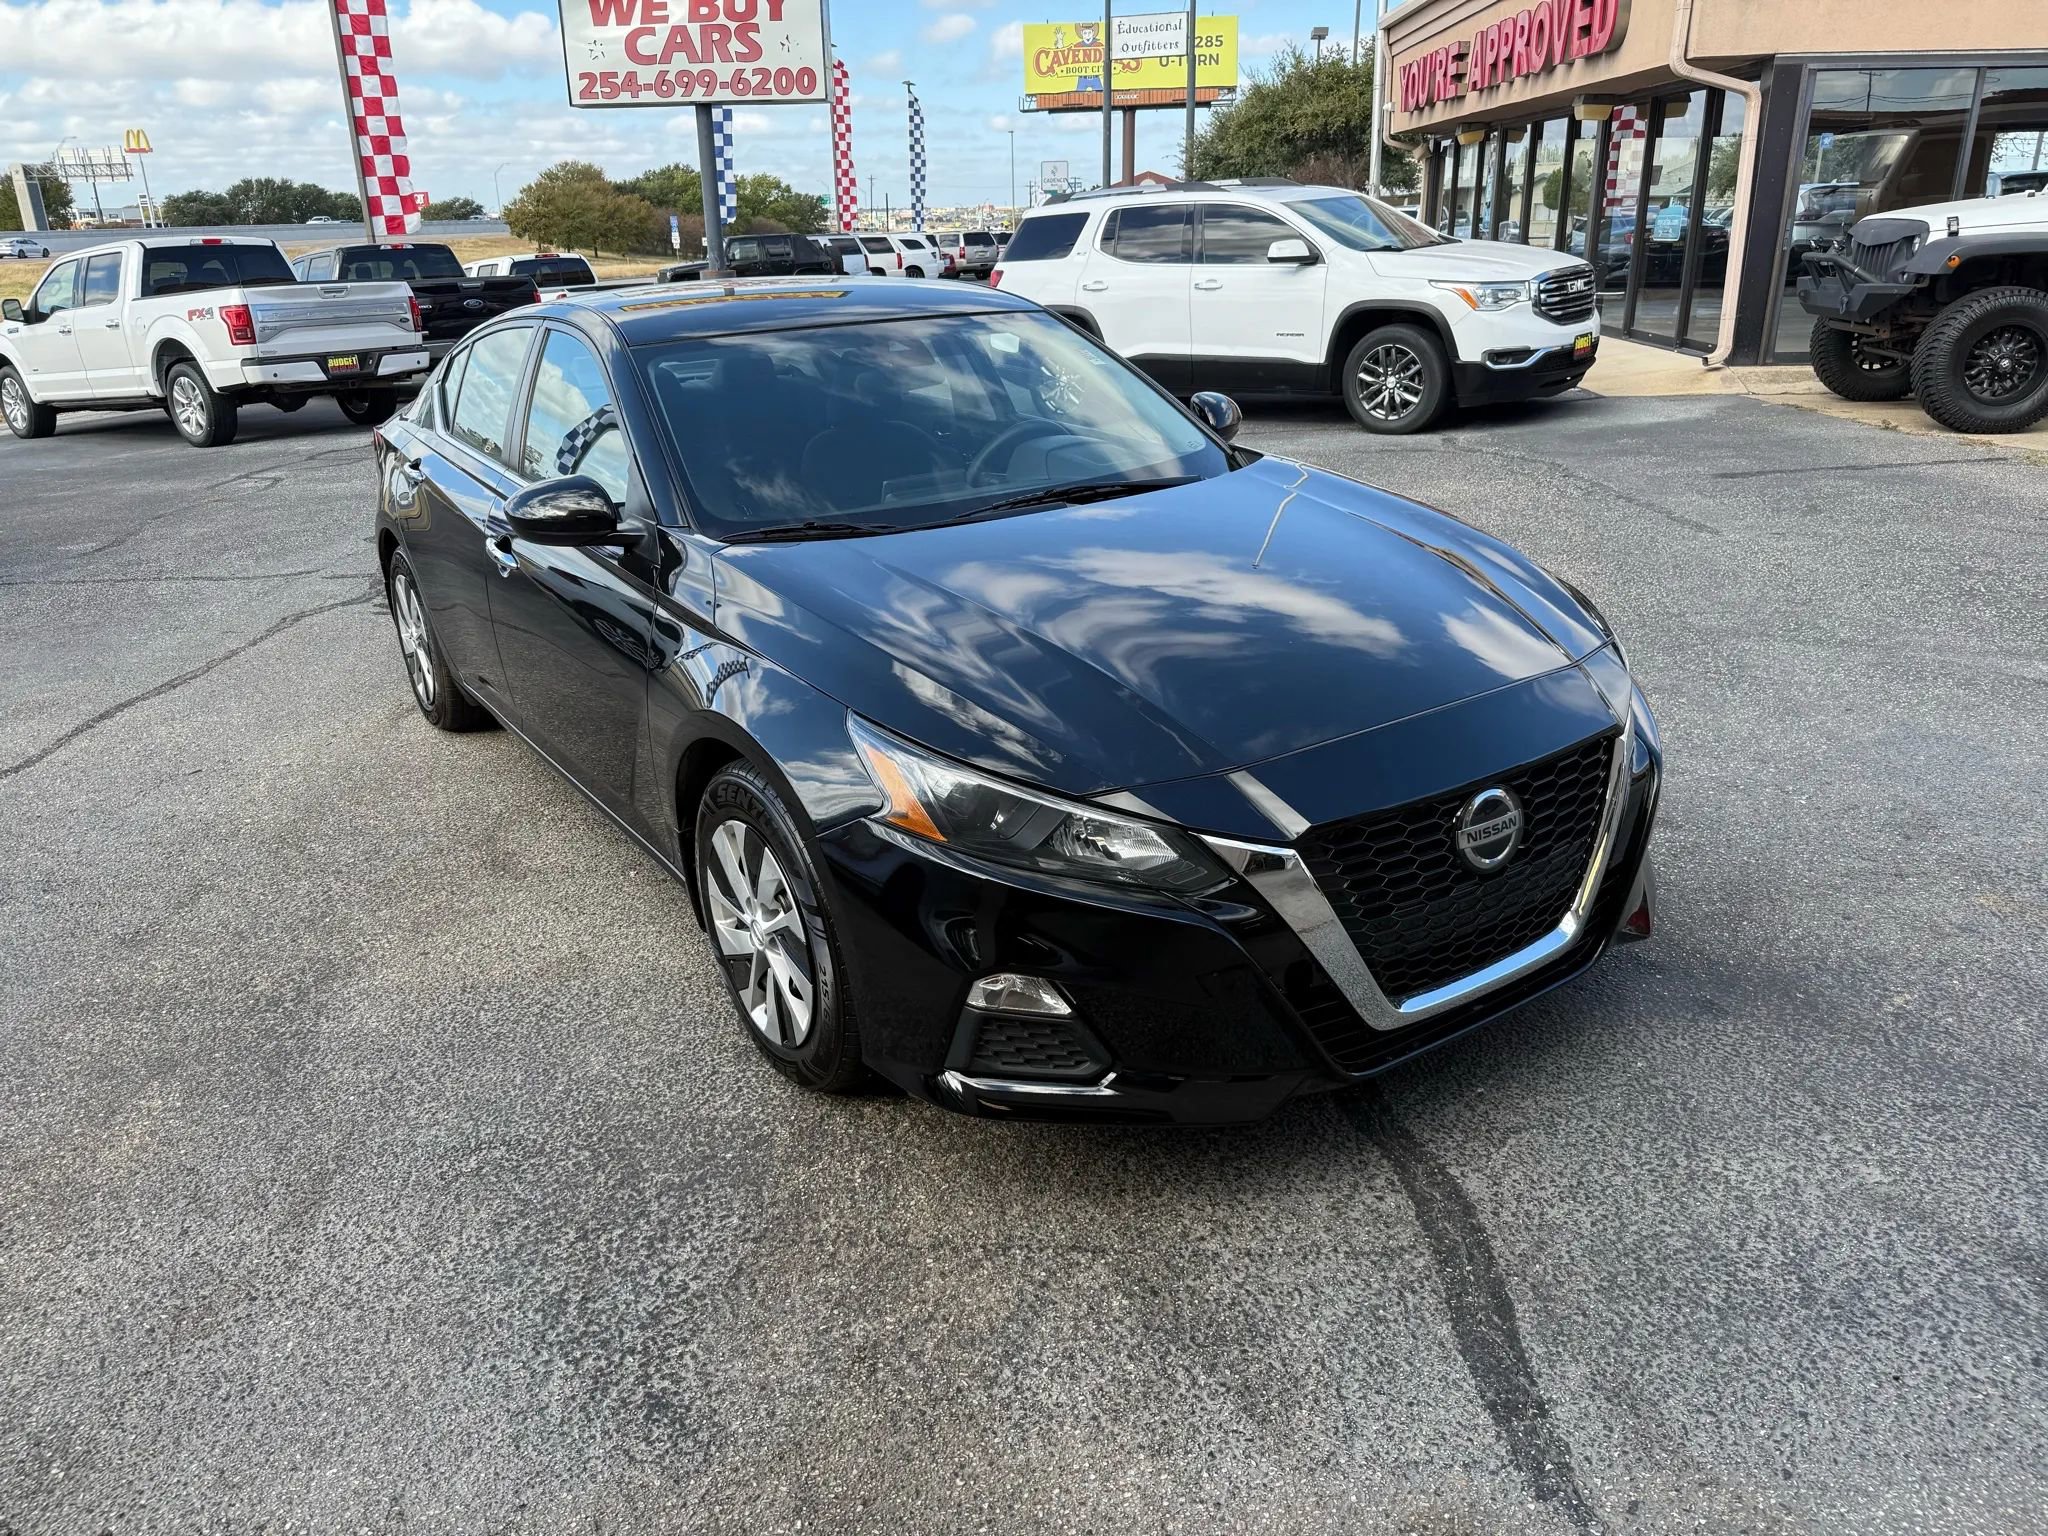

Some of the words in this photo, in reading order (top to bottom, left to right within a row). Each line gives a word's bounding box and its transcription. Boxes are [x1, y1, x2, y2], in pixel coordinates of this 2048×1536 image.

[588, 0, 669, 26] WE
[688, 0, 785, 23] BUY
[1118, 19, 1182, 35] Educational
[624, 23, 763, 65] CARS
[1121, 40, 1179, 54] Outfitters
[1159, 53, 1220, 67] U-TRN
[1400, 41, 1466, 112] YOU'RE
[1469, 0, 1624, 92] APPROVED
[1066, 65, 1089, 75] BOOT
[578, 67, 817, 99] 254-699-6200
[1567, 278, 1590, 293] GMC
[188, 306, 214, 321] FX4
[328, 357, 357, 367] BUDGET
[1466, 815, 1517, 844] NISSAN
